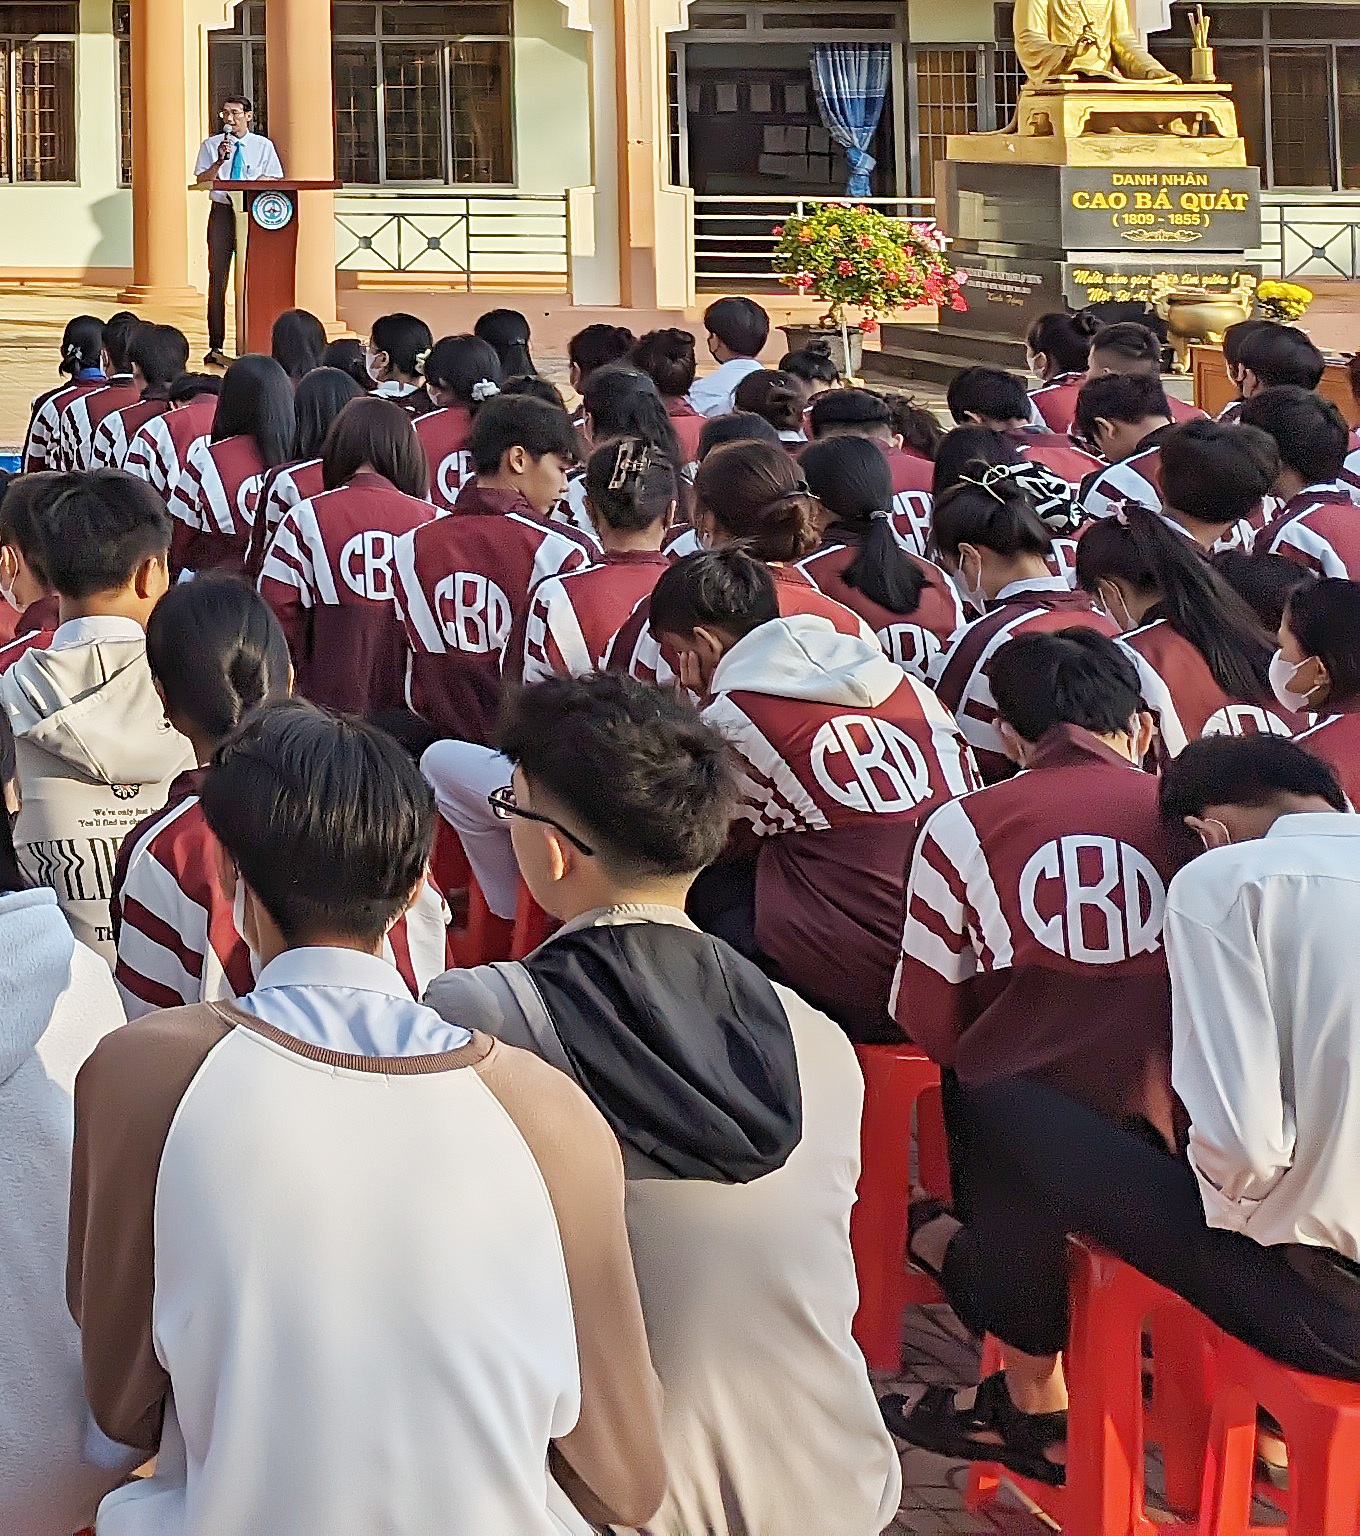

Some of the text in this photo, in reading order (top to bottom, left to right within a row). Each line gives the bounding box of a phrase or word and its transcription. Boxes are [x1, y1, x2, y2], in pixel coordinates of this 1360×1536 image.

[1071, 187, 1250, 212] CAO BÁ QUÁT
[1112, 171, 1209, 186] DANH NHÂN
[1122, 213, 1156, 226] 1809
[1167, 213, 1201, 226] 1855
[339, 530, 394, 601] CB
[434, 571, 514, 653] CBQ
[810, 714, 935, 814] CBQ
[1020, 834, 1167, 964] CBQ
